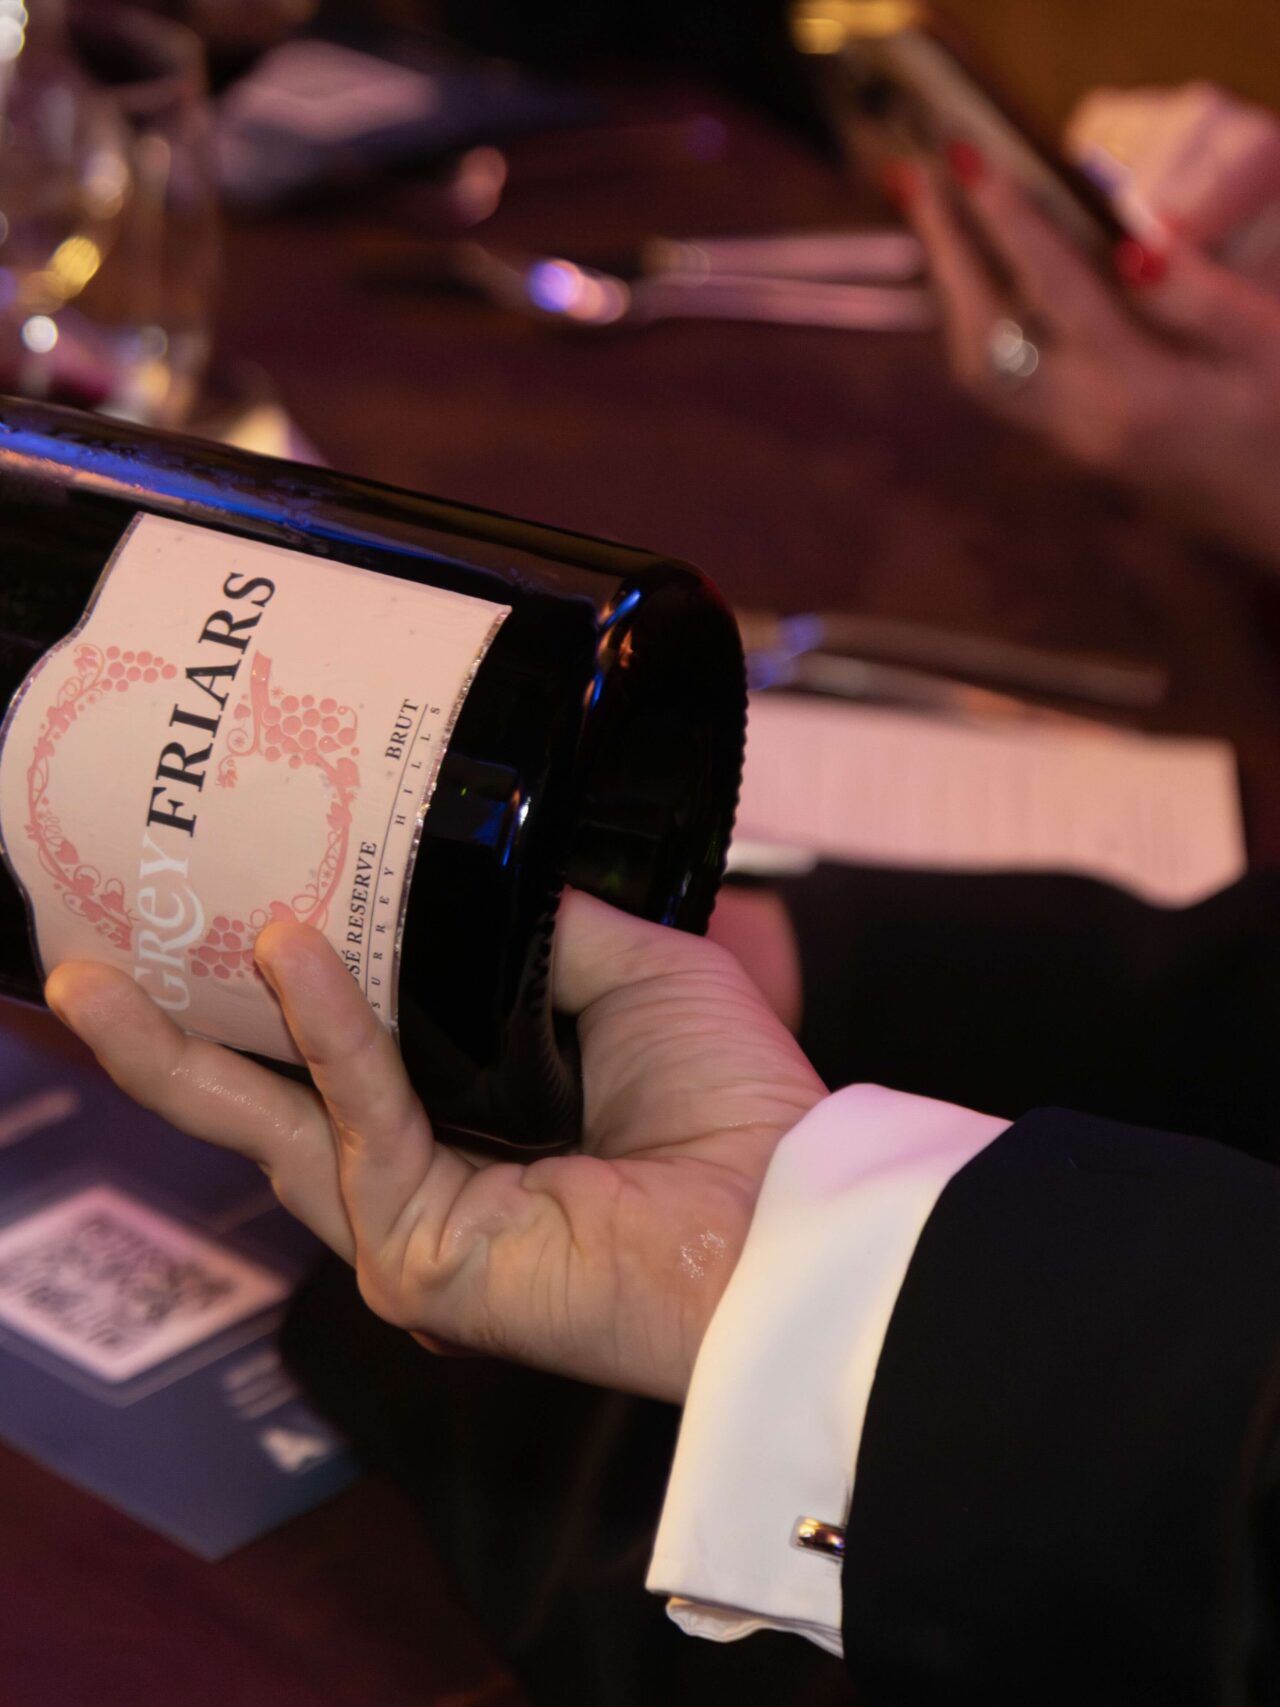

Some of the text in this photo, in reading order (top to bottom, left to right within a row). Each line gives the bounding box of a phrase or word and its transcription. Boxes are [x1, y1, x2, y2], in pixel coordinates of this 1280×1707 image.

[341, 698, 420, 985] SÉ RESERVE BRUT
[370, 706, 441, 1009] SURREY HILLS
